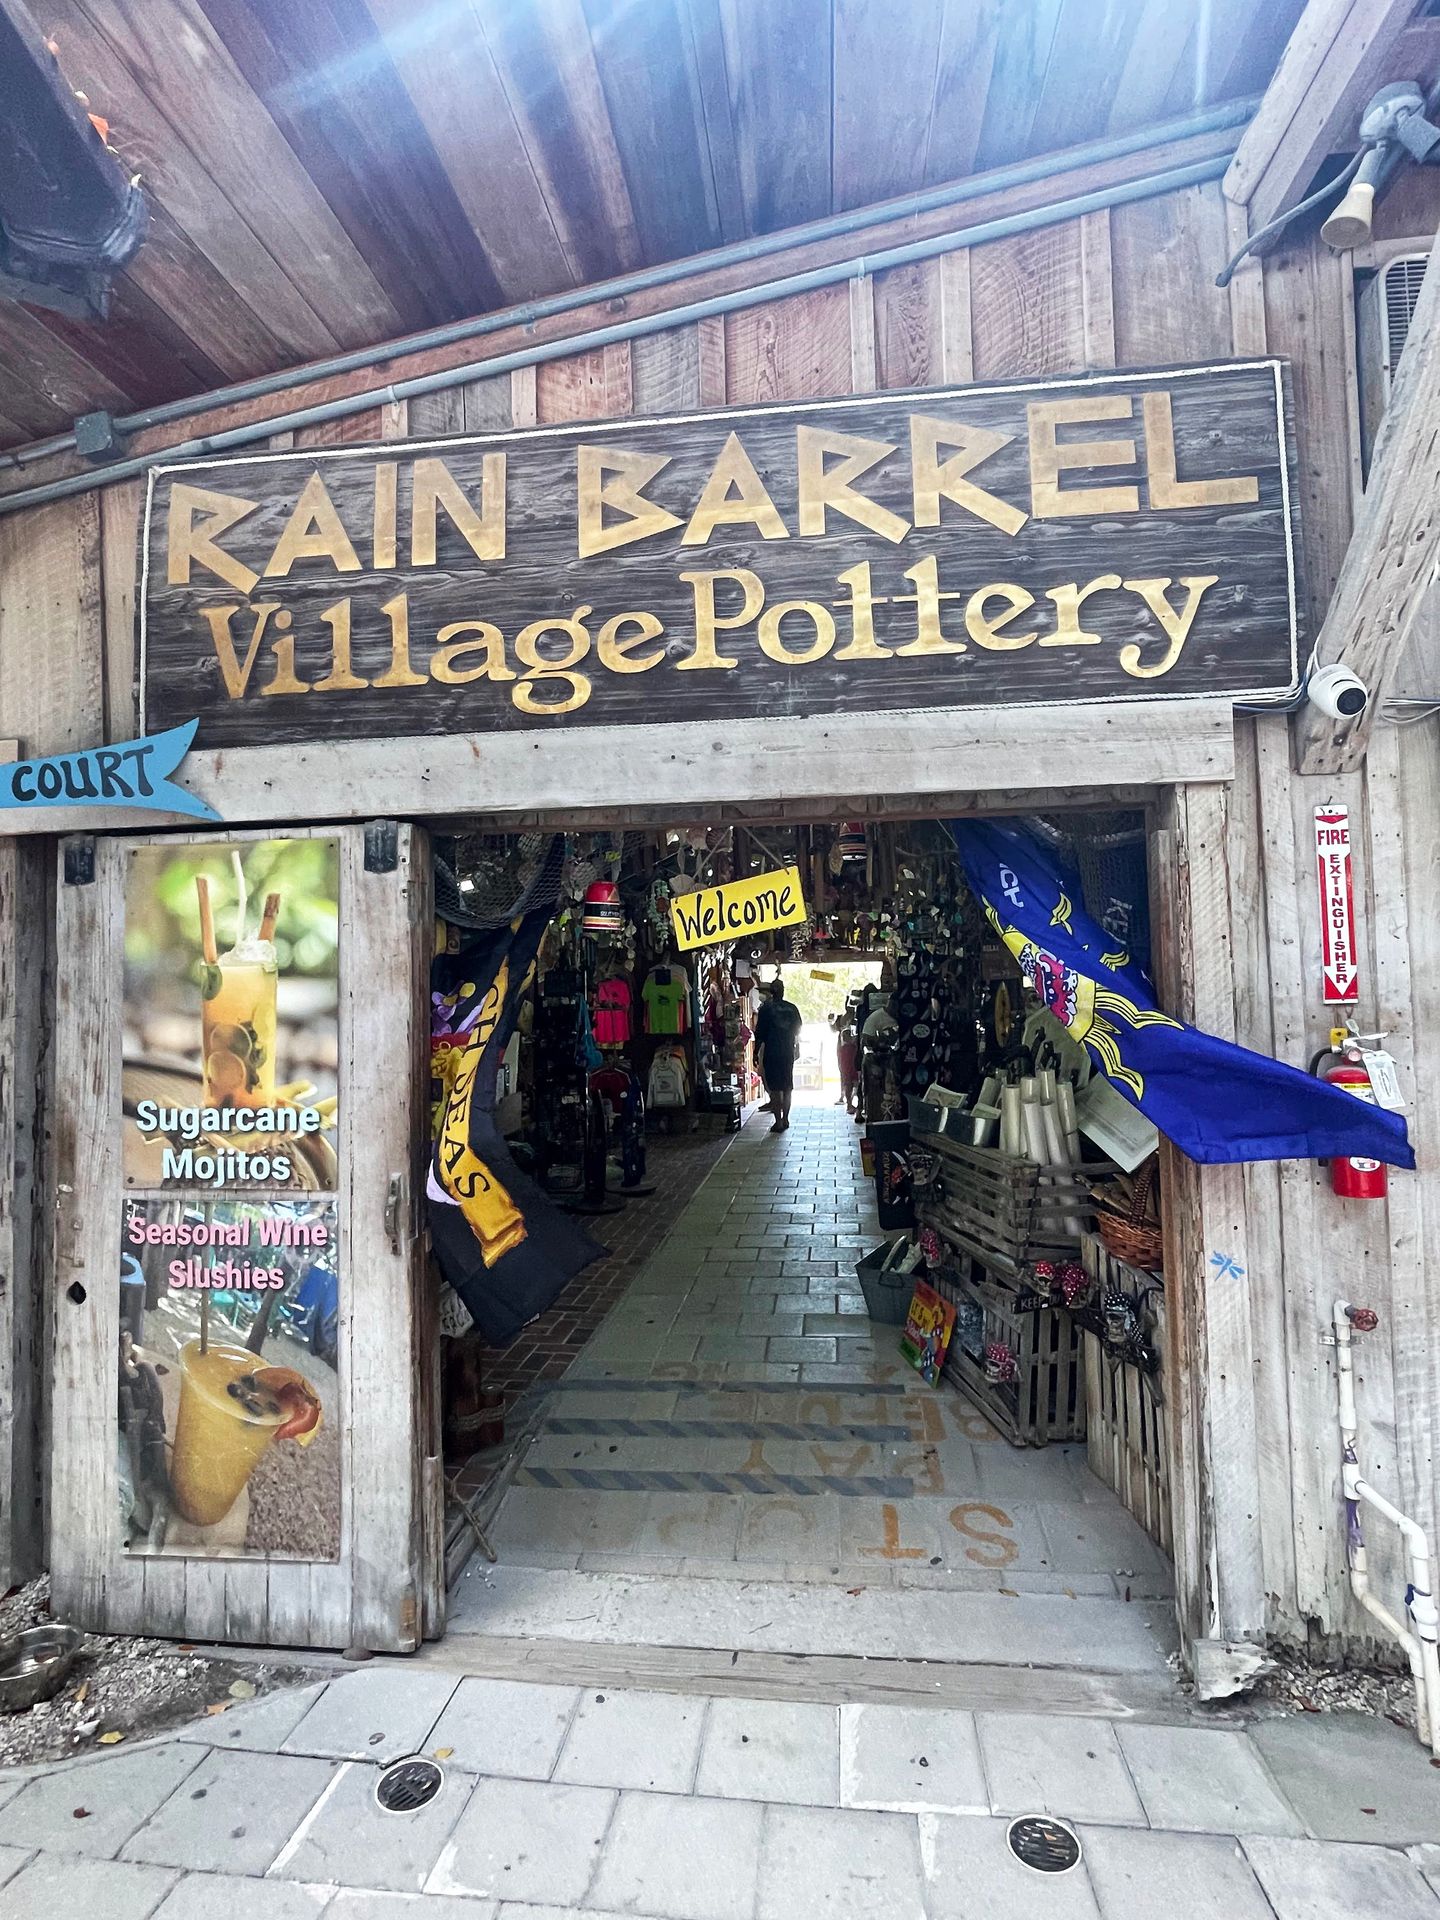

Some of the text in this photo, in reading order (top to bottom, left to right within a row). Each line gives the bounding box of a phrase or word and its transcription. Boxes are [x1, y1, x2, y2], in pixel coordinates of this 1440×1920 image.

[167, 390, 1260, 595] RAIN BARREL
[200, 555, 1220, 715] Village Pottery
[11, 745, 154, 802] COURT
[1317, 829, 1350, 846] FIRE
[676, 886, 796, 941] Welcome
[1329, 854, 1348, 984] EXTINGUISHER
[136, 1100, 321, 1140] Sugarcane
[162, 1147, 291, 1188] Mojitos
[128, 1216, 328, 1246] Seasonal Wine
[168, 1259, 285, 1290] Slushies
